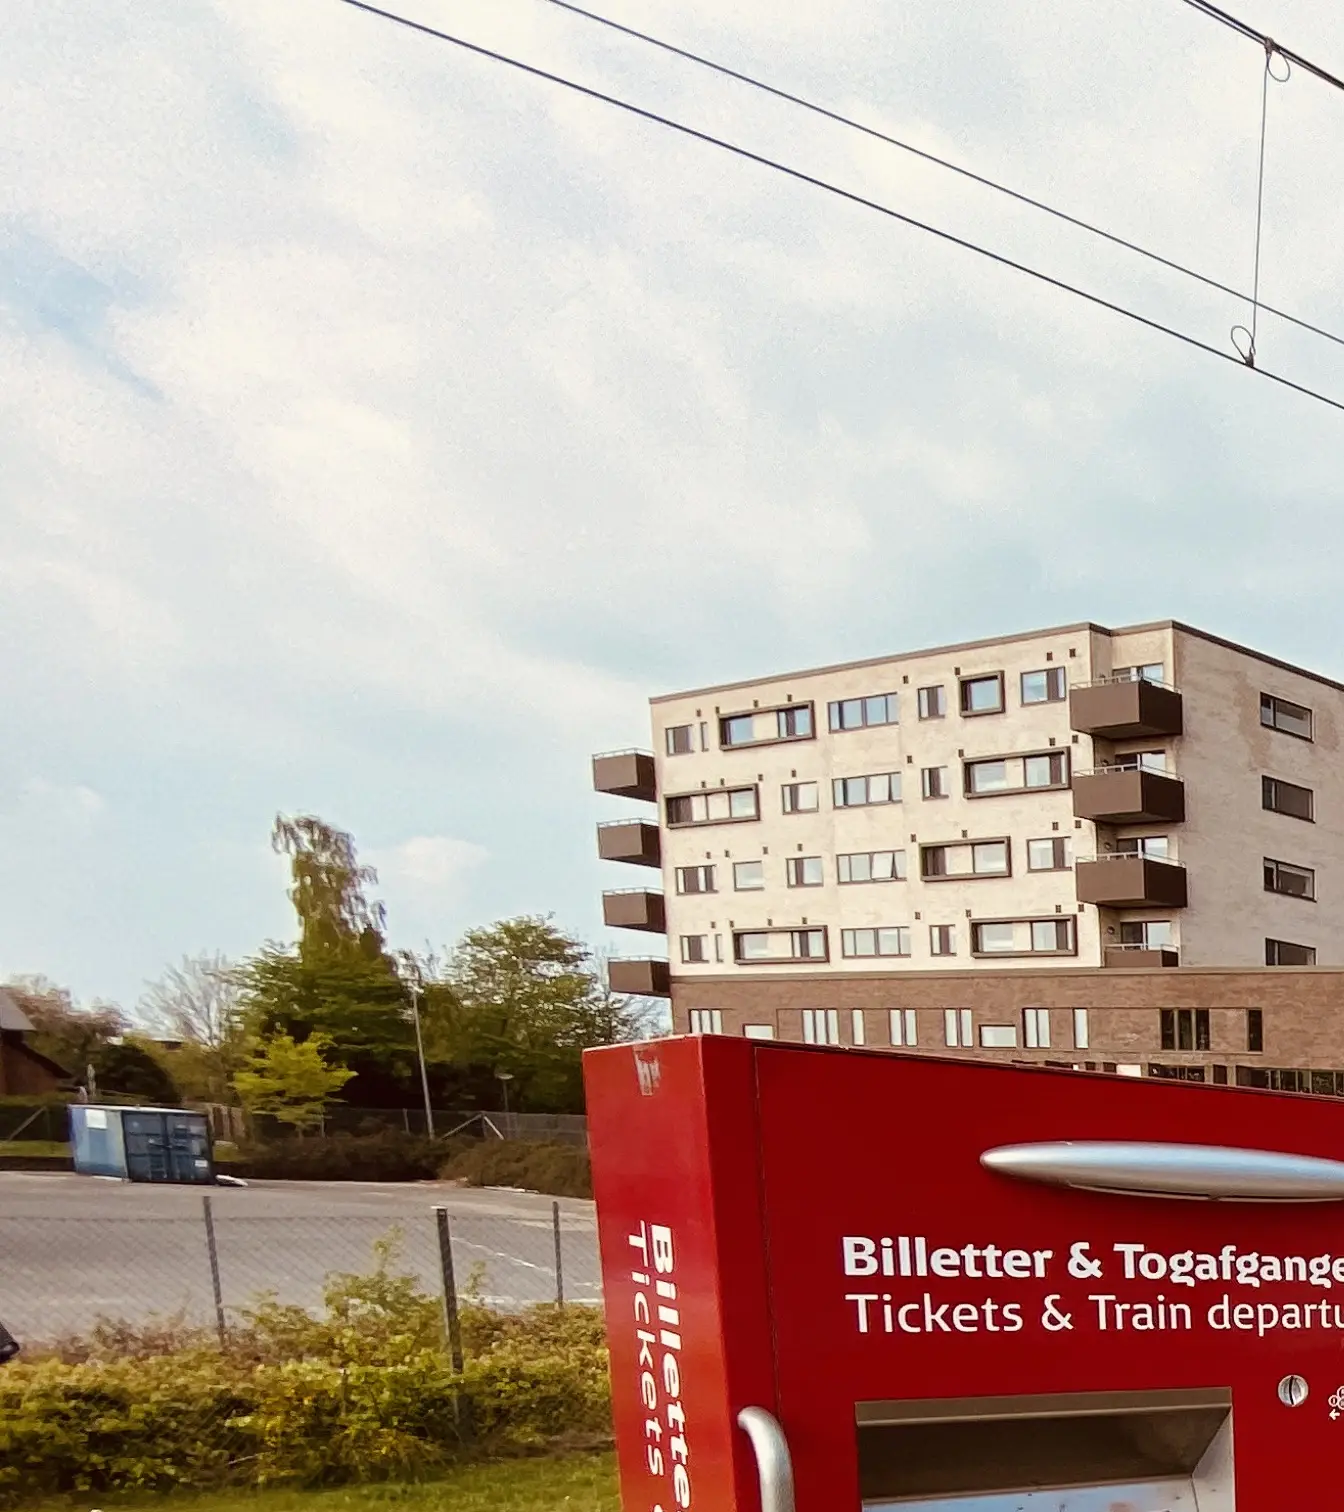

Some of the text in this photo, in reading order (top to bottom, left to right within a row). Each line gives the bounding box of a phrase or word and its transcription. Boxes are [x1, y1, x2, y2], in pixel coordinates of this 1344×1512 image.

[842, 1236, 1053, 1279] Billetter
[1067, 1242, 1103, 1279] &
[845, 1293, 1023, 1334] Tickets
[1041, 1294, 1074, 1331] &
[1089, 1295, 1192, 1331] Train
[628, 1220, 664, 1477] Tickets
